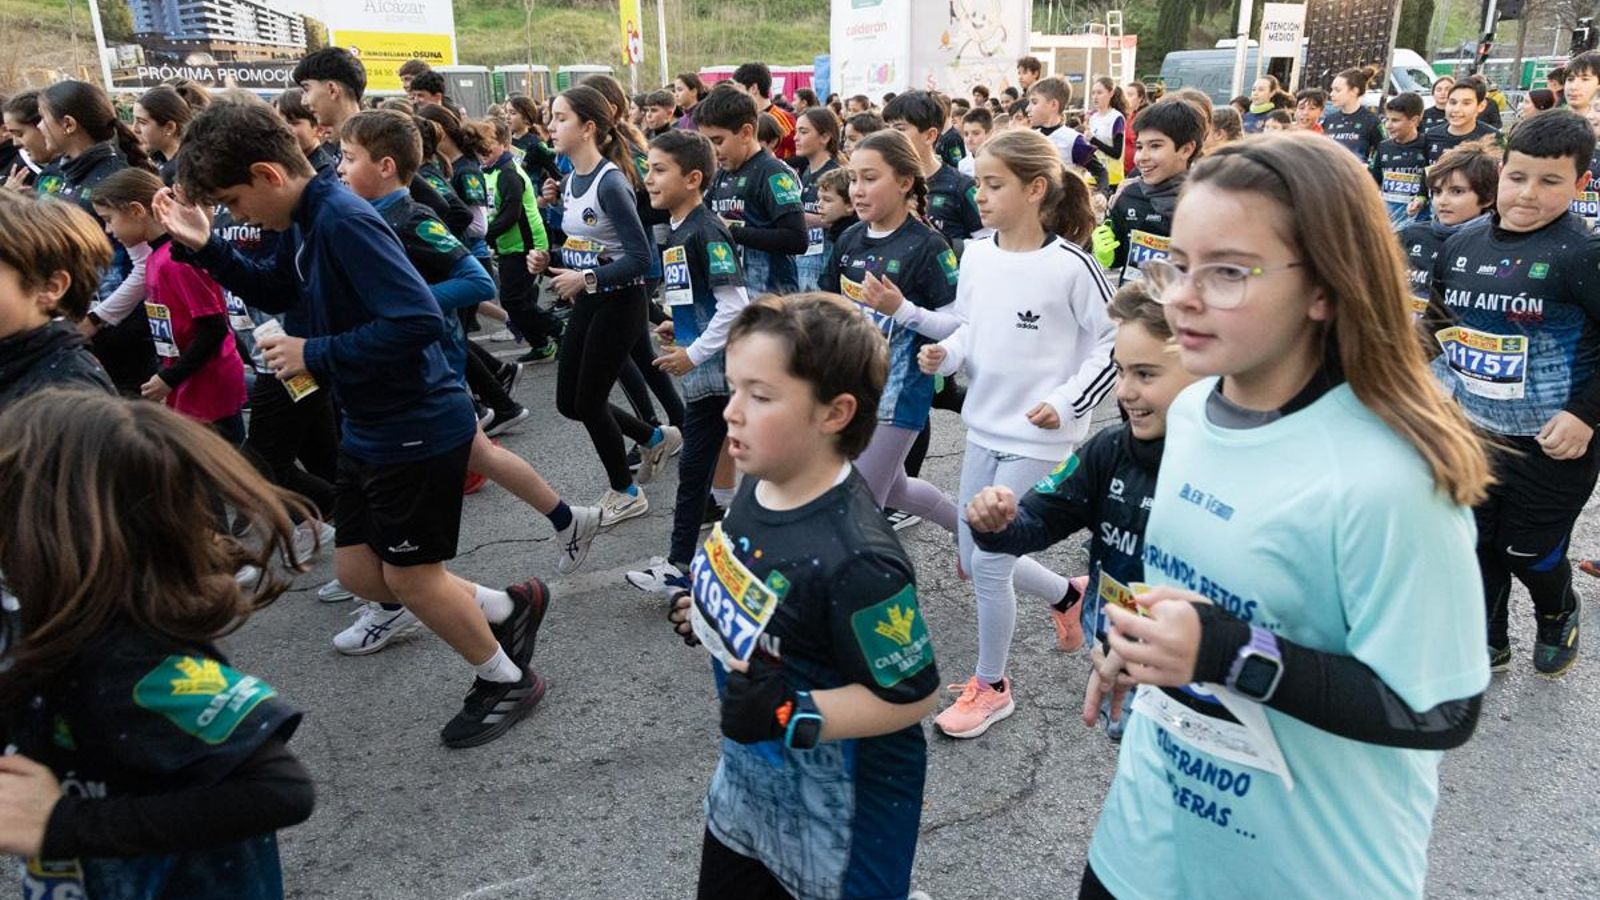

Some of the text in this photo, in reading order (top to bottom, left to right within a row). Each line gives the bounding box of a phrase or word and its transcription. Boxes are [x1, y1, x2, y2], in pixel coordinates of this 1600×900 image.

[1268, 32, 1295, 42] MEDIOS
[137, 63, 215, 80] PRÓXIMA
[1384, 180, 1420, 193] 11235
[1444, 289, 1543, 315] SAN ANTÓN
[1447, 342, 1522, 376] 11757
[1100, 521, 1138, 556] SAN
[691, 554, 757, 651] 11937
